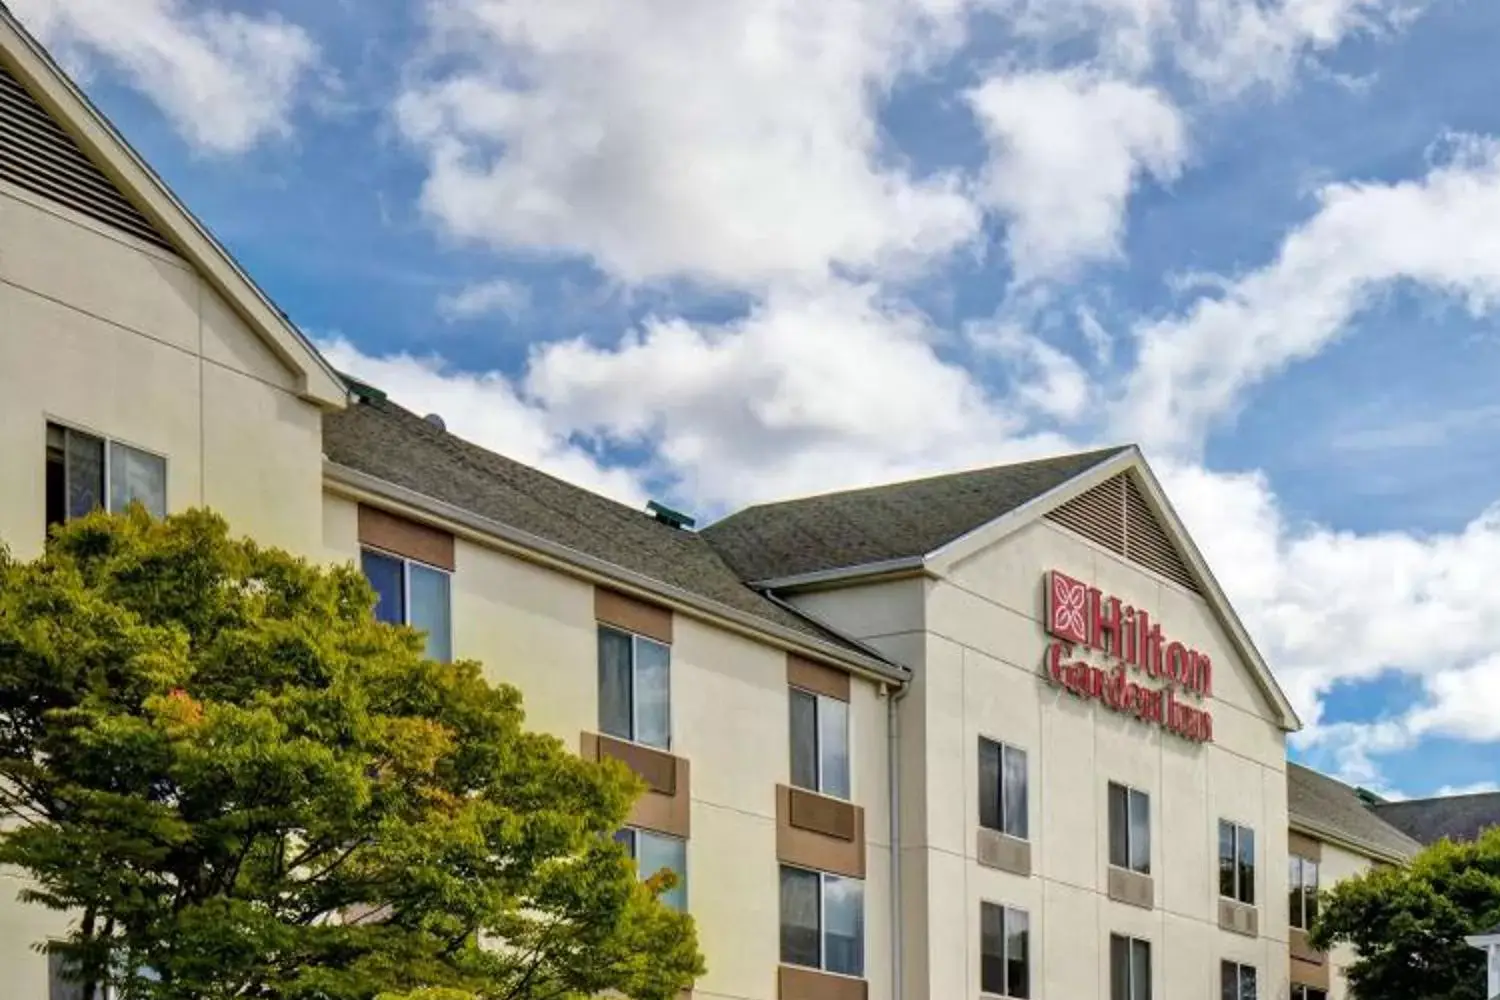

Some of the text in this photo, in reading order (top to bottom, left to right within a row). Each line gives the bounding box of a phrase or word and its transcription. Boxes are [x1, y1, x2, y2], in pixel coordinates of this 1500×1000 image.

[1046, 642, 1213, 743] Garden Inn
[1088, 587, 1213, 698] Hilton
